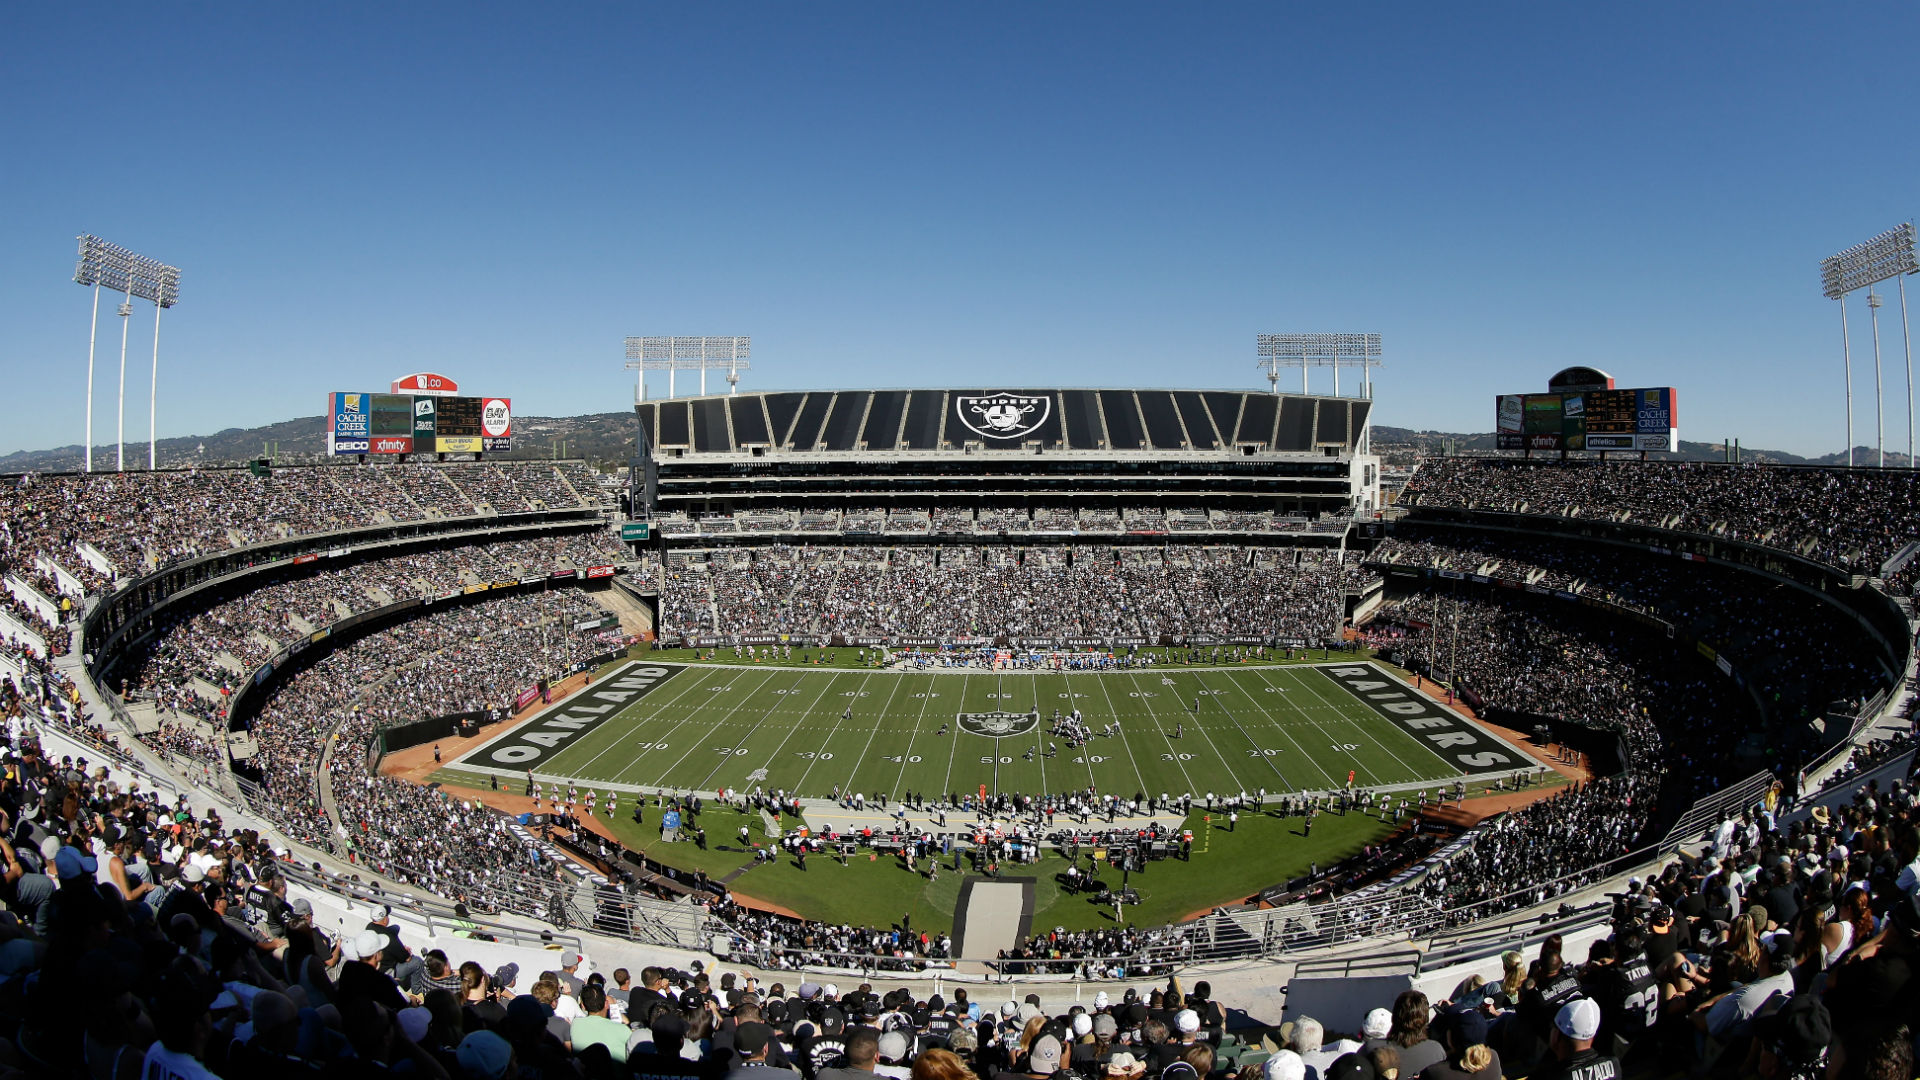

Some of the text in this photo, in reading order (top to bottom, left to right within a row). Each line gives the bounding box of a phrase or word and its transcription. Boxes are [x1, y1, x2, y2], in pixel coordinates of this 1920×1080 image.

[337, 413, 367, 422] CACHE
[1638, 409, 1668, 419] CACHE
[337, 422, 367, 431] CREEK
[1638, 419, 1668, 428] CREEK
[335, 441, 369, 451] GEICO
[377, 439, 406, 452] xfinity
[1531, 435, 1557, 448] xfinity
[491, 667, 669, 764] OAKLAND
[1328, 667, 1511, 767] RAIDERS
[641, 742, 669, 750] 10
[1330, 743, 1357, 752] 10
[718, 747, 749, 757] 20
[801, 751, 834, 761] 30
[1160, 752, 1192, 761] 30
[1246, 748, 1277, 758] 20
[889, 755, 923, 764] 40
[980, 756, 1013, 764] 50
[1071, 755, 1105, 764] 40
[1625, 965, 1651, 982] TATUM
[931, 1021, 949, 1029] BROWN
